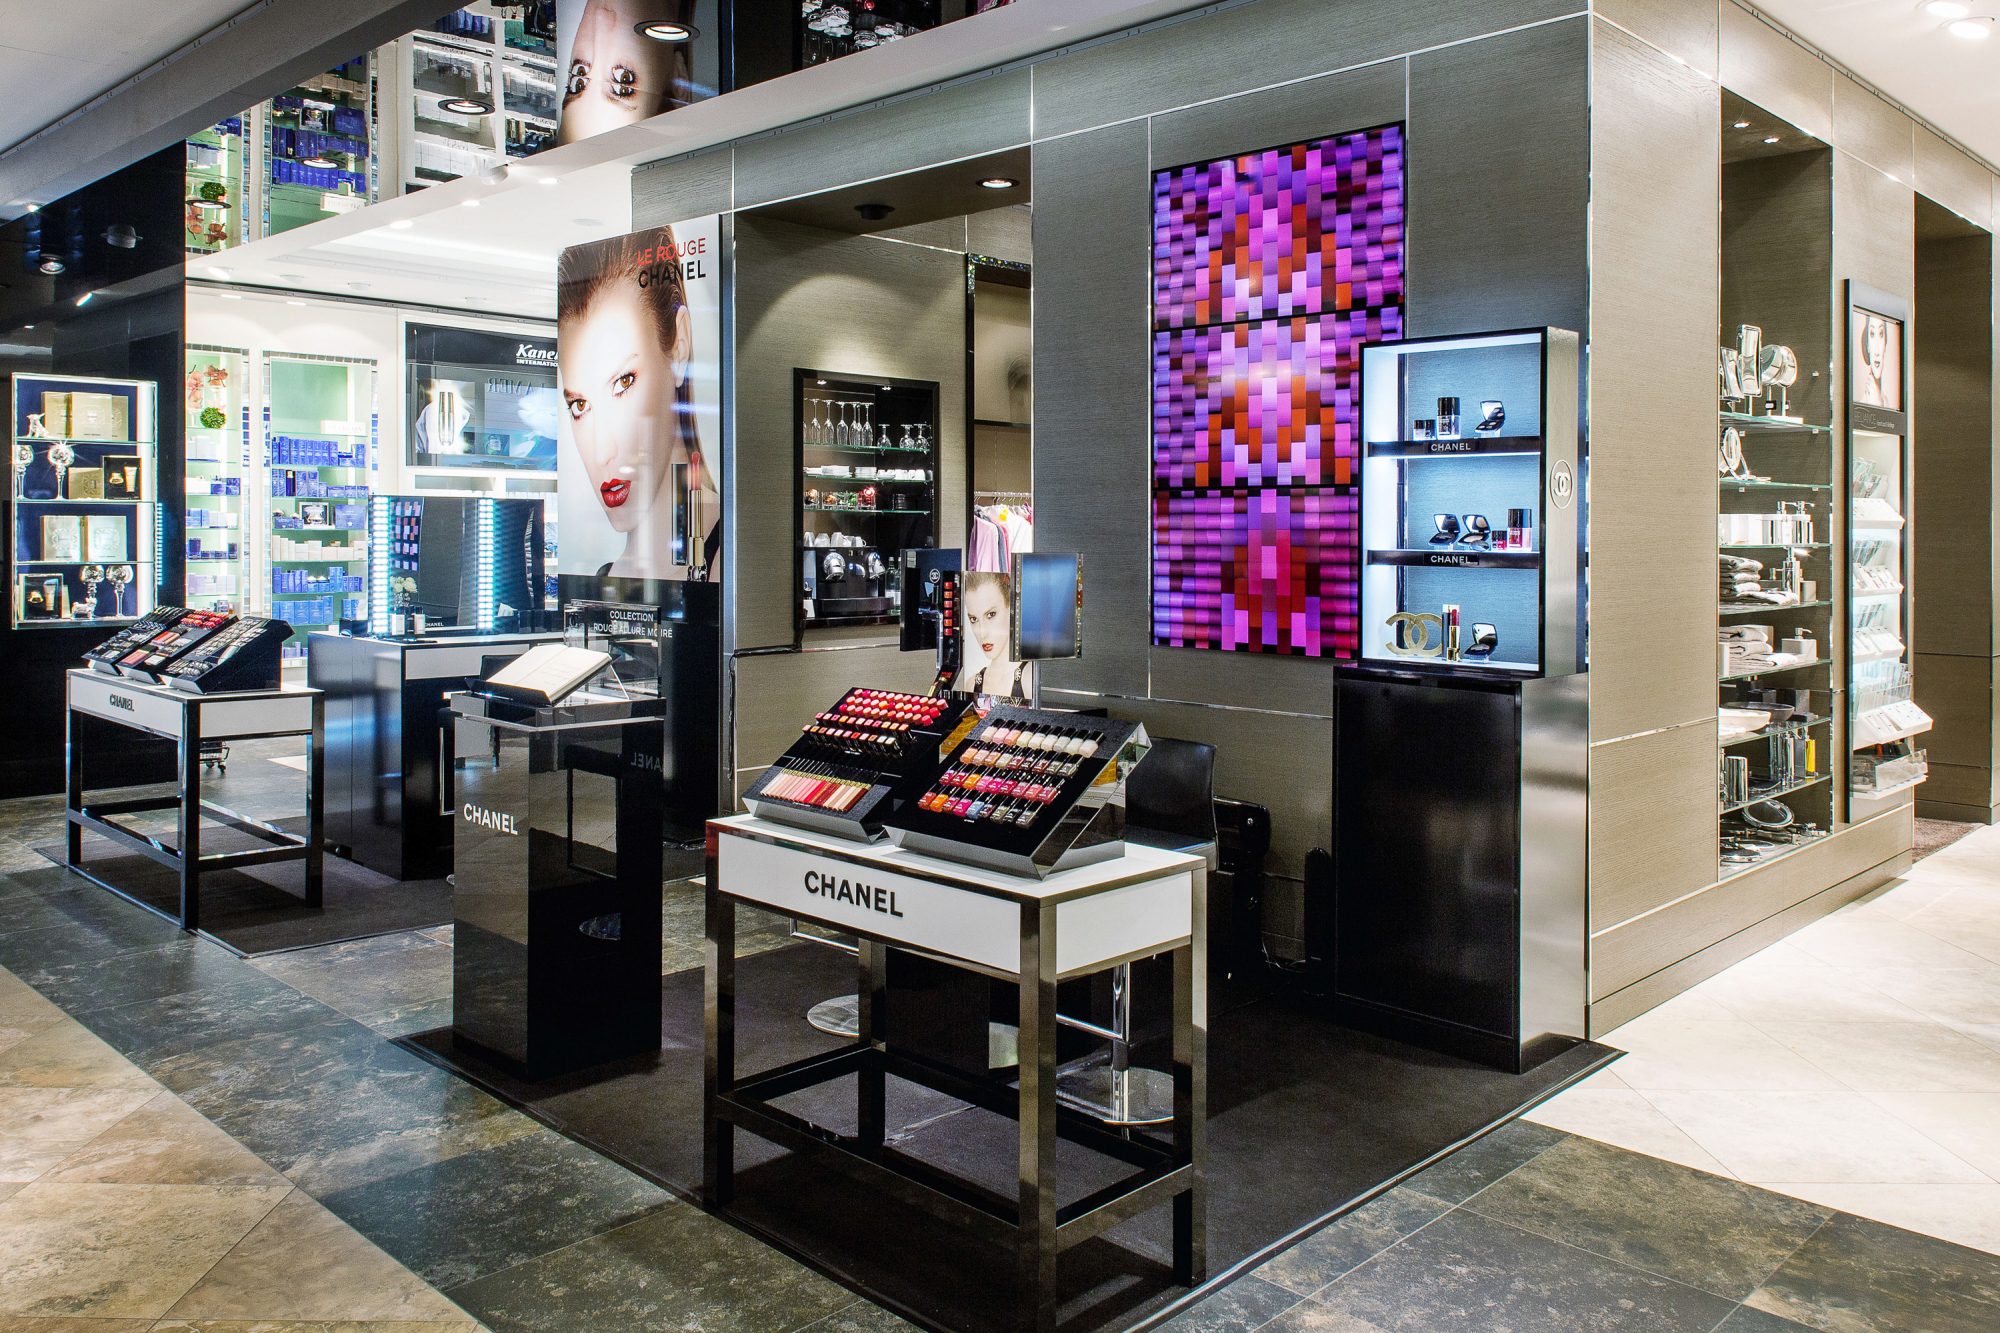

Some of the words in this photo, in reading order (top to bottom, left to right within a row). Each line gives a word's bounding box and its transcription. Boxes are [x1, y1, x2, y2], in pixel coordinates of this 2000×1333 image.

[636, 248, 653, 266] LE
[657, 237, 706, 261] ROUGE
[638, 259, 706, 288] CHANEL
[1431, 443, 1471, 451] CHANEL
[1430, 555, 1471, 564] CHANEL
[610, 610, 654, 621] COLLECTION
[593, 622, 618, 633] ROUGE
[619, 626, 646, 636] ALLURE
[463, 803, 518, 835] CHANEL
[804, 870, 904, 917] CHANEL
